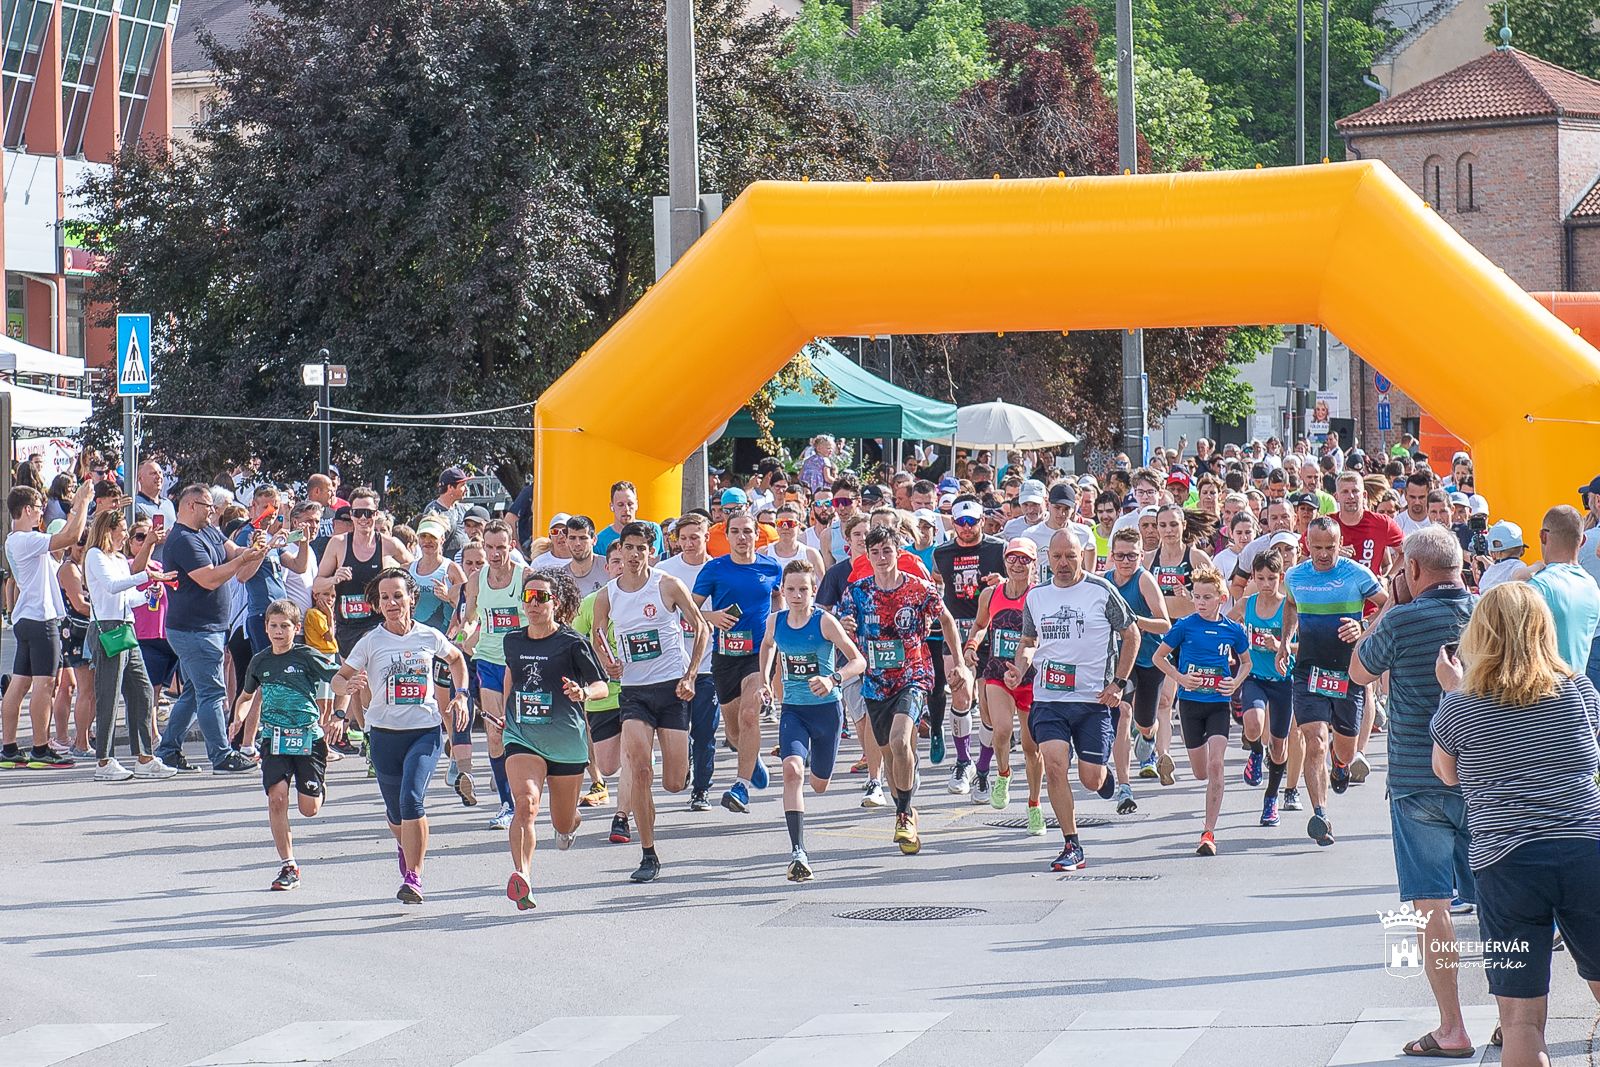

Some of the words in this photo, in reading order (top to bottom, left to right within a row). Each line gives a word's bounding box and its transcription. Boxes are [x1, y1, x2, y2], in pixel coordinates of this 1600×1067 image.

[1359, 539, 1374, 569] das
[1161, 575, 1177, 584] 428
[348, 604, 363, 612] 343
[497, 617, 512, 626] 376
[1041, 624, 1070, 633] BUDAPEST
[1042, 632, 1070, 640] MARATON
[636, 643, 649, 653] 21
[728, 641, 745, 650] 427
[1004, 641, 1019, 651] 707
[1218, 643, 1230, 656] 18
[878, 651, 897, 661] 722
[793, 664, 807, 674] 20
[1049, 673, 1066, 684] 399
[1321, 679, 1339, 690] 313
[400, 686, 420, 696] 333
[525, 705, 539, 715] 24
[285, 738, 303, 747] 758
